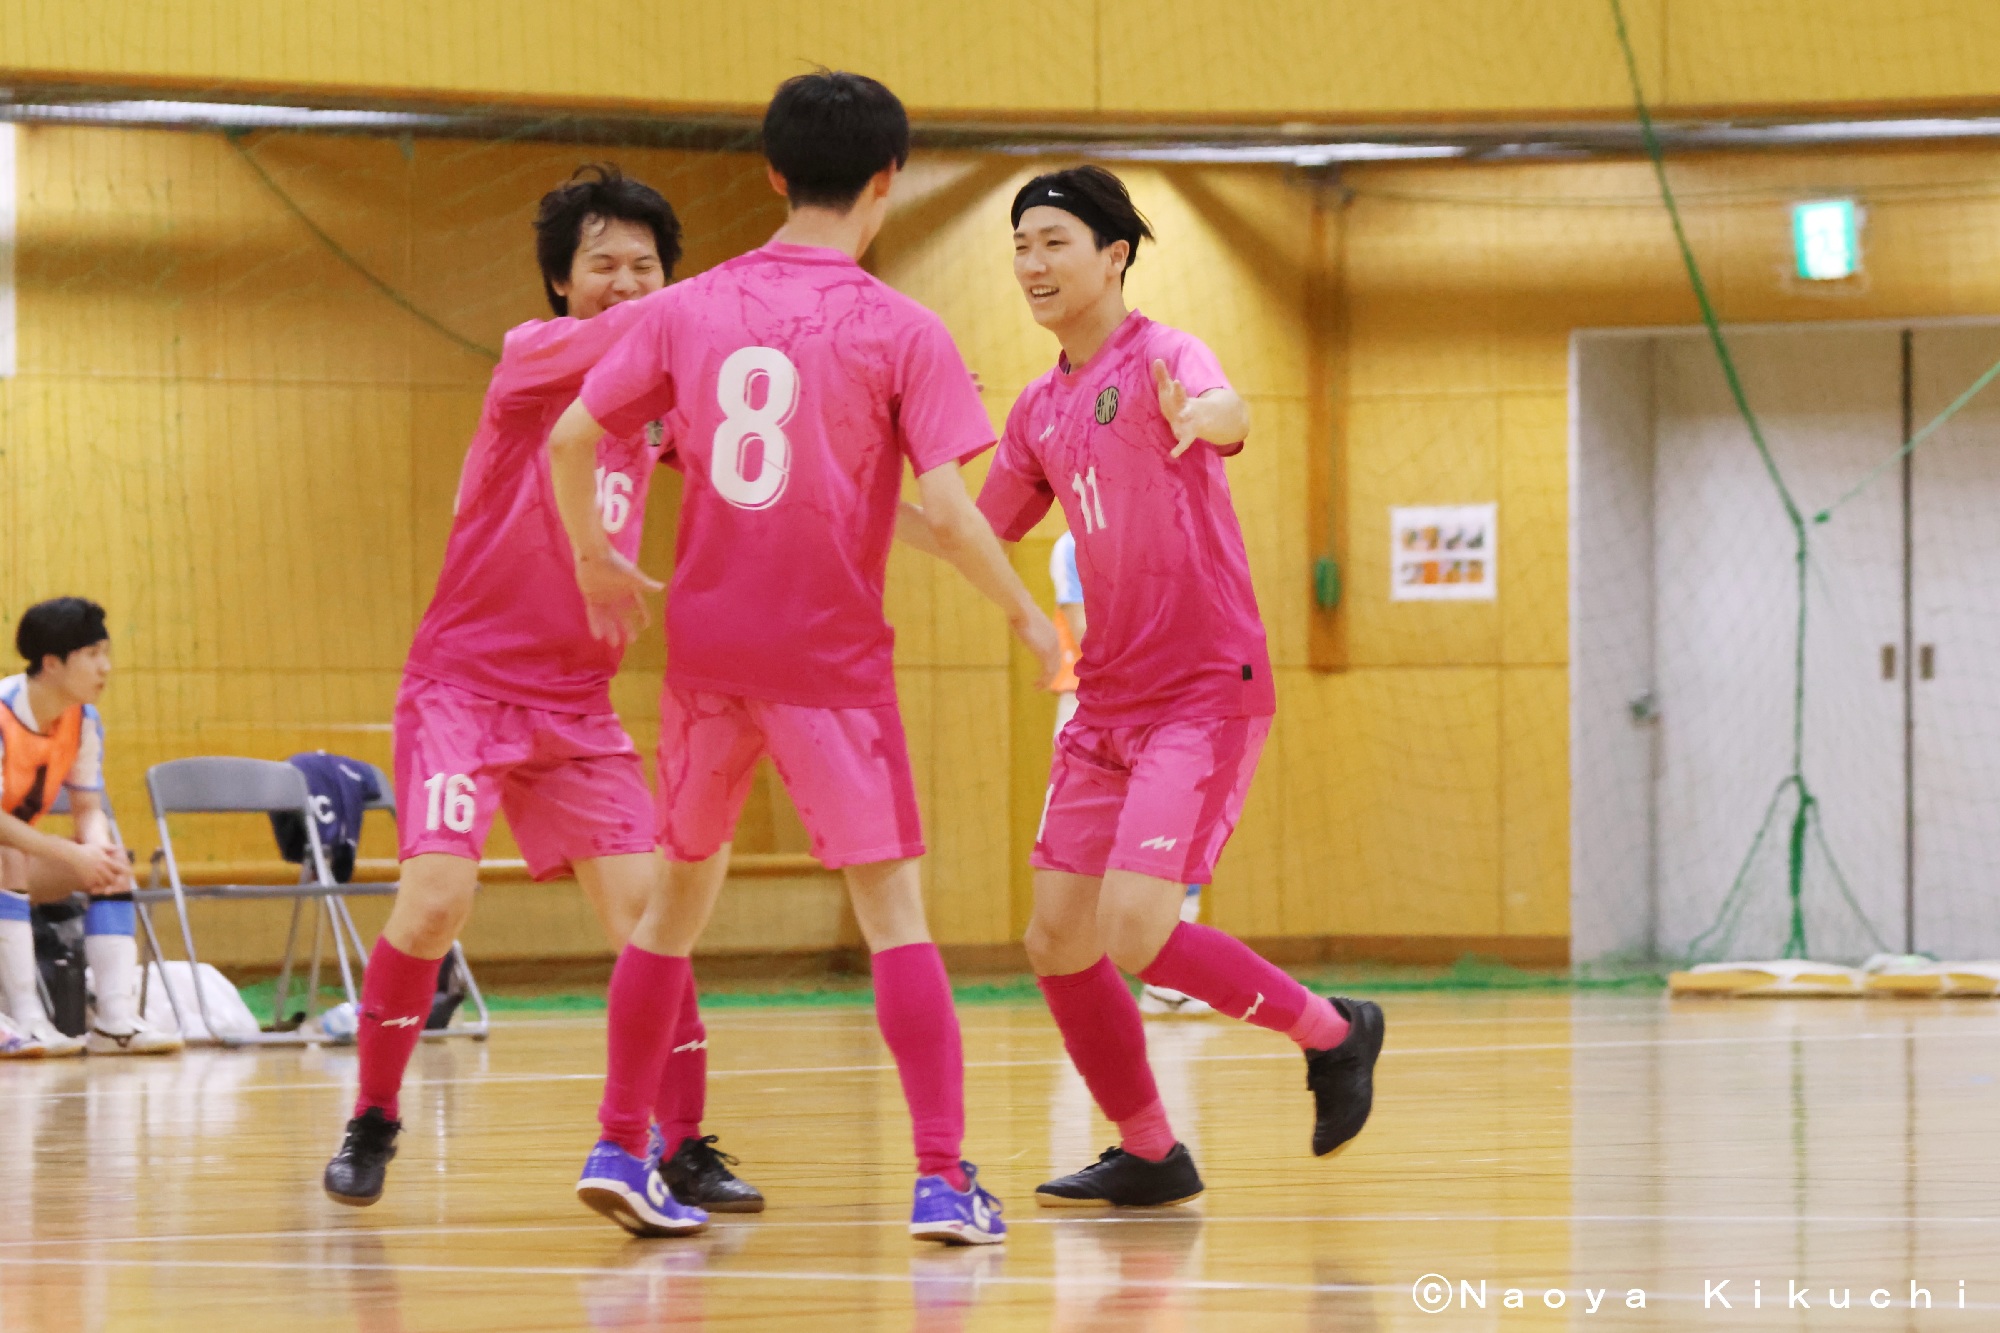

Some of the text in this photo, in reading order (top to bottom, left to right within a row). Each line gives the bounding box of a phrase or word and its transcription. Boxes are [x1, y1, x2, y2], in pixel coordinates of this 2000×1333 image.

[711, 346, 800, 511] 8
[1071, 466, 1107, 534] 11
[424, 772, 477, 833] 16
